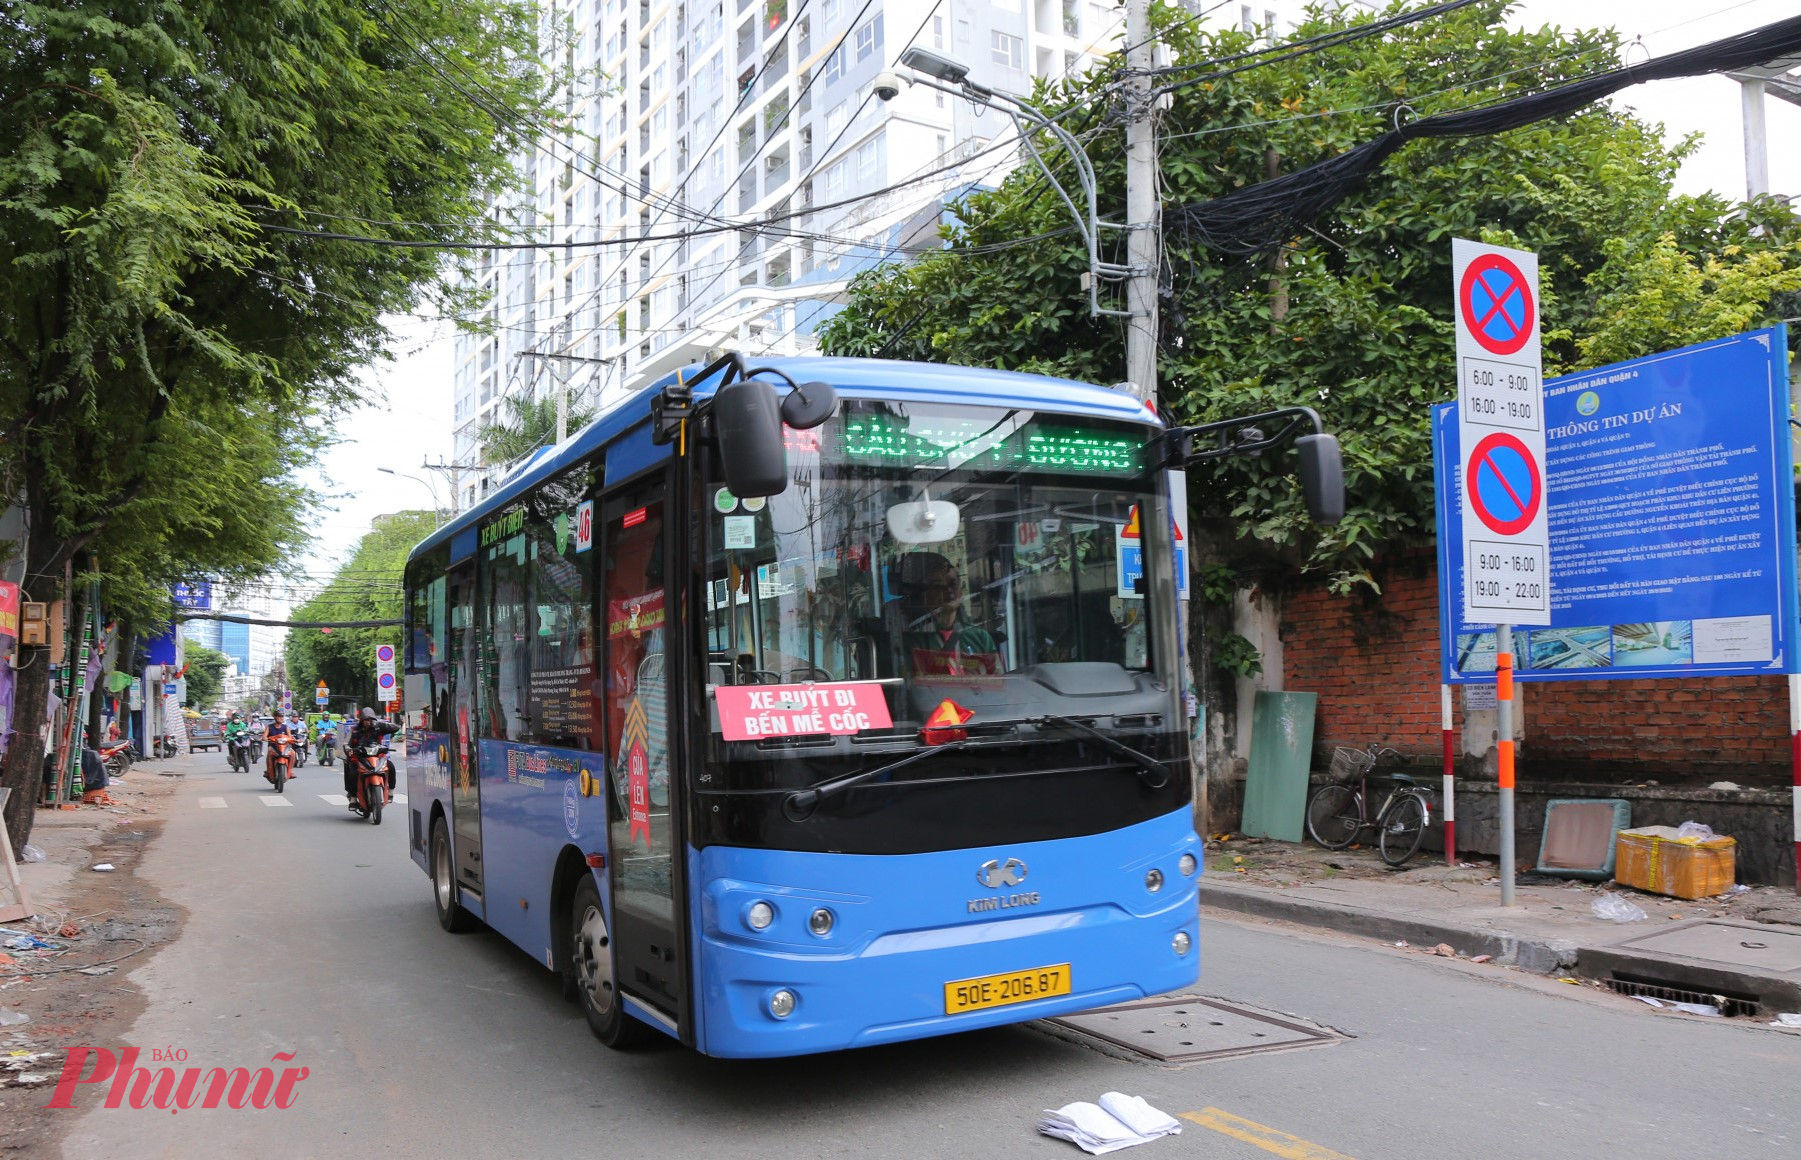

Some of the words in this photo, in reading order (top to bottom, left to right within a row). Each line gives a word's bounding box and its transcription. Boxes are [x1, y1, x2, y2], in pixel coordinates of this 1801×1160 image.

[1474, 370, 1493, 386] 6:00
[1509, 375, 1527, 391] 9:00
[1550, 386, 1566, 397] BAN
[1567, 379, 1588, 393] NHÂN
[1590, 375, 1608, 388] DÂN
[1608, 371, 1631, 387] QUẬN
[1472, 397, 1495, 414] 16:00
[1508, 402, 1530, 418] 19:00
[1547, 419, 1599, 440] THÔNG
[1602, 413, 1628, 430] TIN
[1632, 405, 1656, 424] DỰ
[1659, 402, 1682, 418] ÁN
[482, 527, 490, 547] XE
[579, 509, 590, 543] 46
[1480, 554, 1500, 570] 9:00
[1512, 556, 1534, 572] 16:00
[1475, 581, 1499, 597] 19:00
[1516, 583, 1540, 599] 22:00
[748, 691, 774, 710] XE
[834, 690, 857, 707] ĐI
[744, 710, 790, 735] BẾN
[792, 707, 825, 732] MỄ
[829, 706, 870, 730] CỐC
[633, 749, 644, 776] CỬA
[634, 780, 644, 805] LÊN
[968, 896, 998, 913] KIM
[1002, 892, 1041, 910] LONG
[957, 971, 1060, 1006] 50E-206.87
